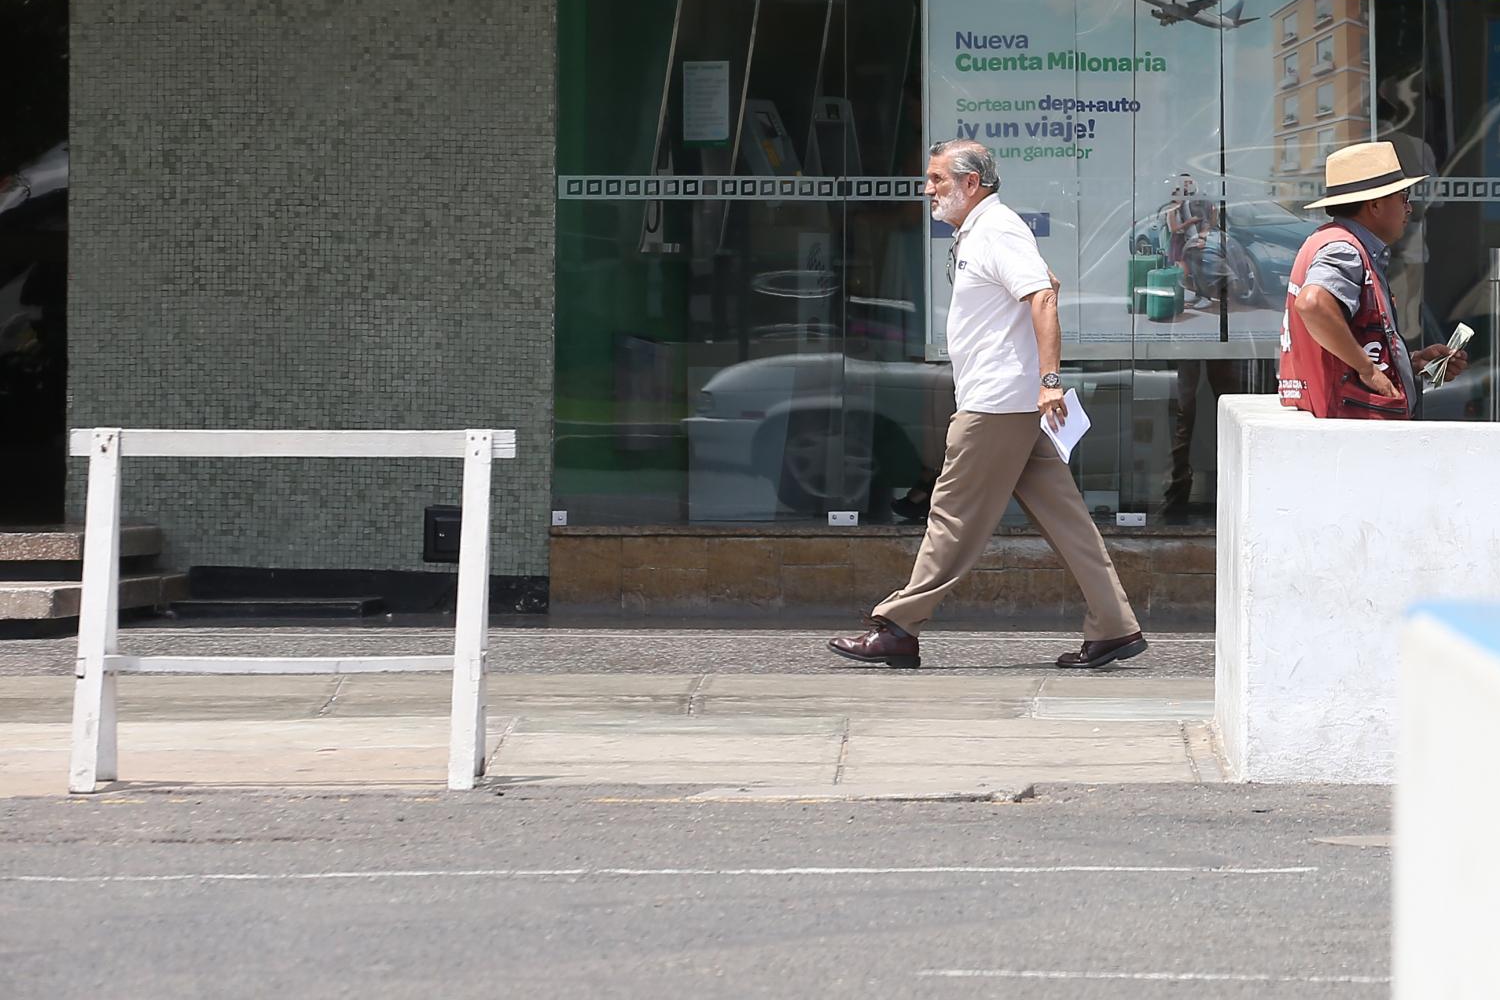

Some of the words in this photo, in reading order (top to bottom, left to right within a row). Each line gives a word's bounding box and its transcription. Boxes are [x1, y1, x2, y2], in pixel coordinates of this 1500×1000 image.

[955, 31, 1029, 50] Nueva
[955, 53, 1043, 72] Cuenta
[1047, 50, 1167, 72] Millonaria
[956, 98, 1012, 112] Sortea
[1014, 99, 1036, 111] un
[986, 121, 1019, 138] un
[1025, 115, 1096, 142] viaje!
[1000, 146, 1021, 158] un
[1024, 143, 1093, 161] ganador
